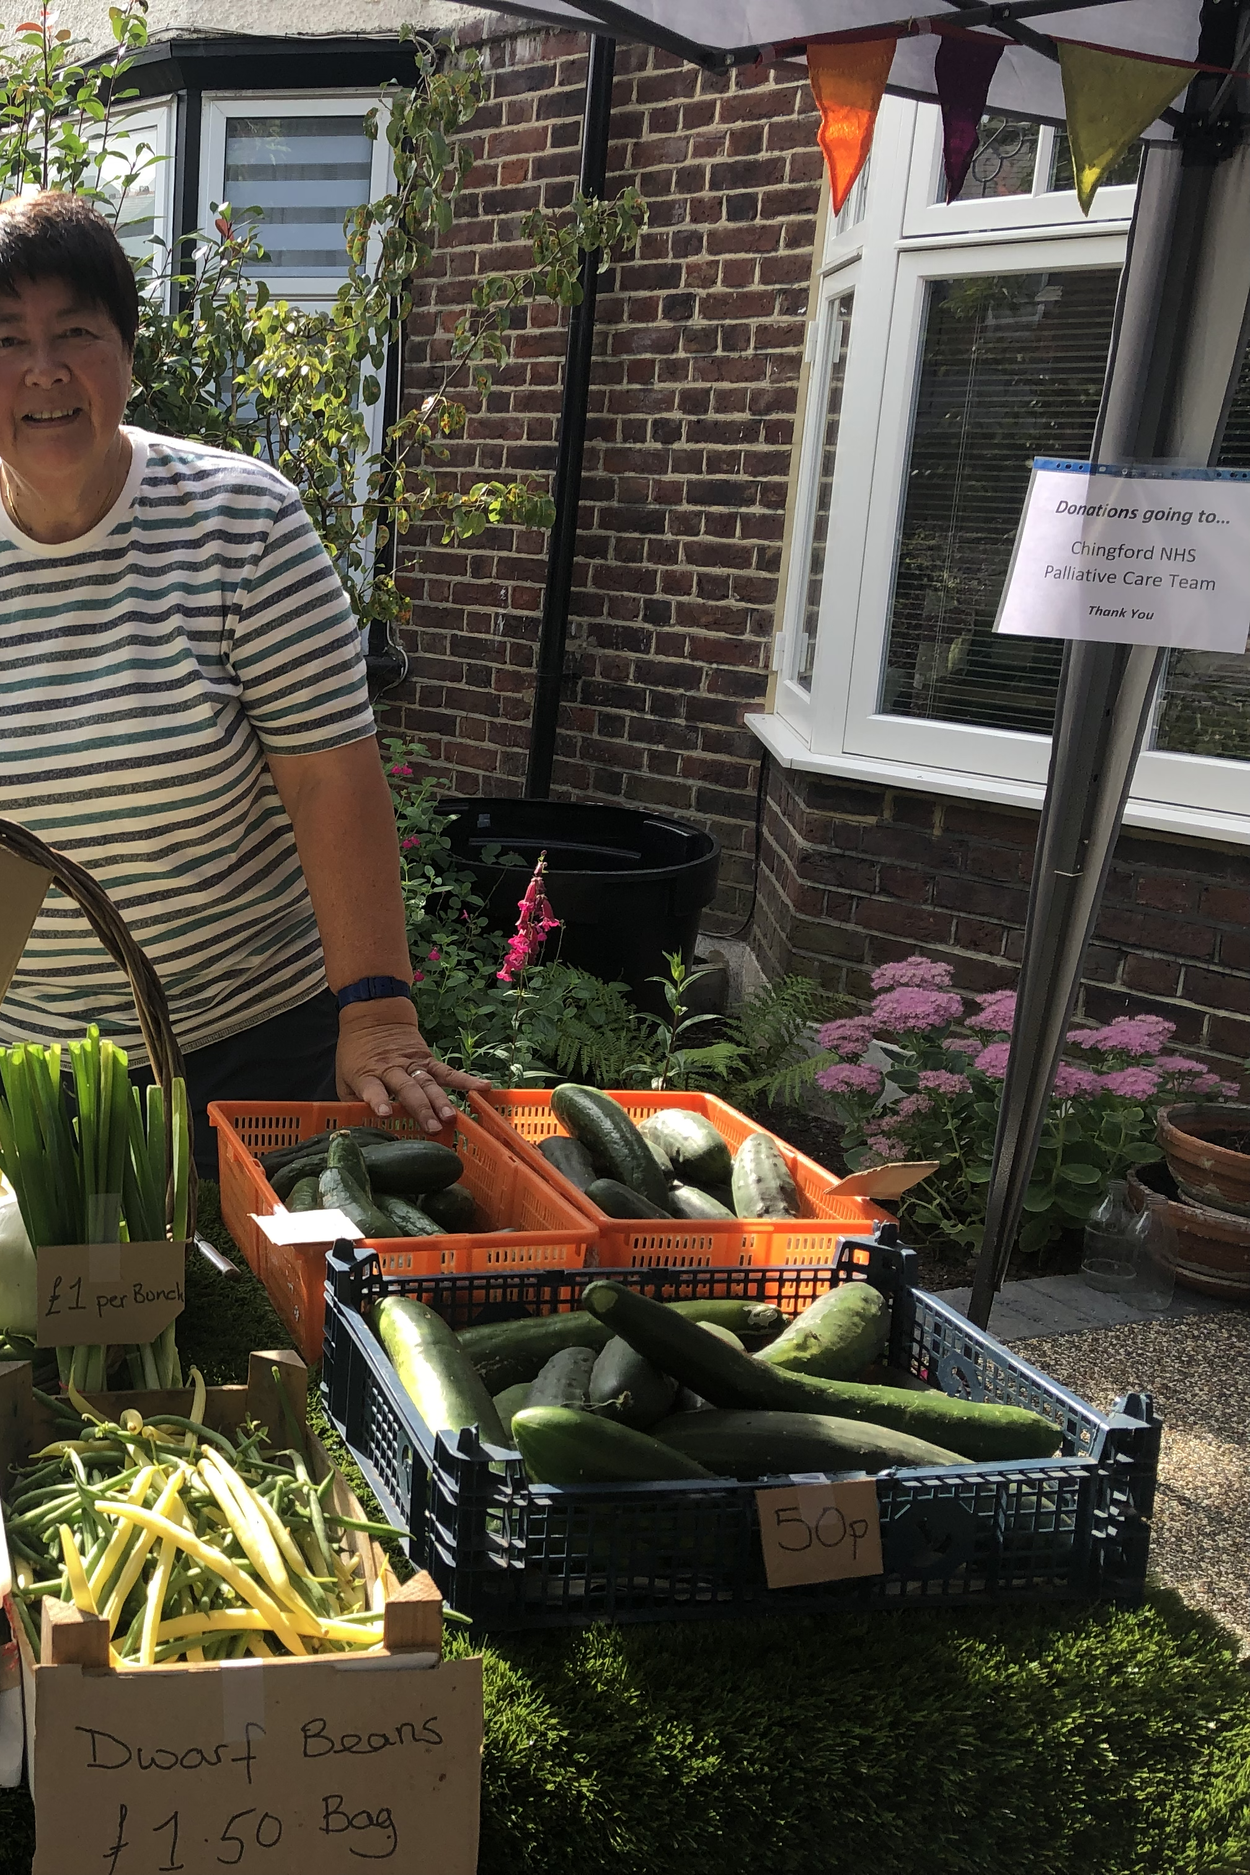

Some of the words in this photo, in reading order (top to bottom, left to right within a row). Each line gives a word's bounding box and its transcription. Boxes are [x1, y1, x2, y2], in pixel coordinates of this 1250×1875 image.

[1055, 500, 1139, 520] Donations
[1142, 507, 1193, 526] going
[1071, 540, 1155, 562] Chingford
[1160, 547, 1196, 563] NHS
[1044, 564, 1117, 585] Palliative
[1123, 571, 1163, 588] Care
[1168, 573, 1216, 592] Team
[1088, 605, 1126, 618] Thank
[1130, 609, 1155, 621] You
[45, 1275, 87, 1316] £1
[96, 1293, 128, 1318] per
[774, 1506, 869, 1561] 50p
[75, 1721, 267, 1784] Dwarf
[300, 1716, 444, 1759] Beans
[319, 1794, 399, 1860] Bag
